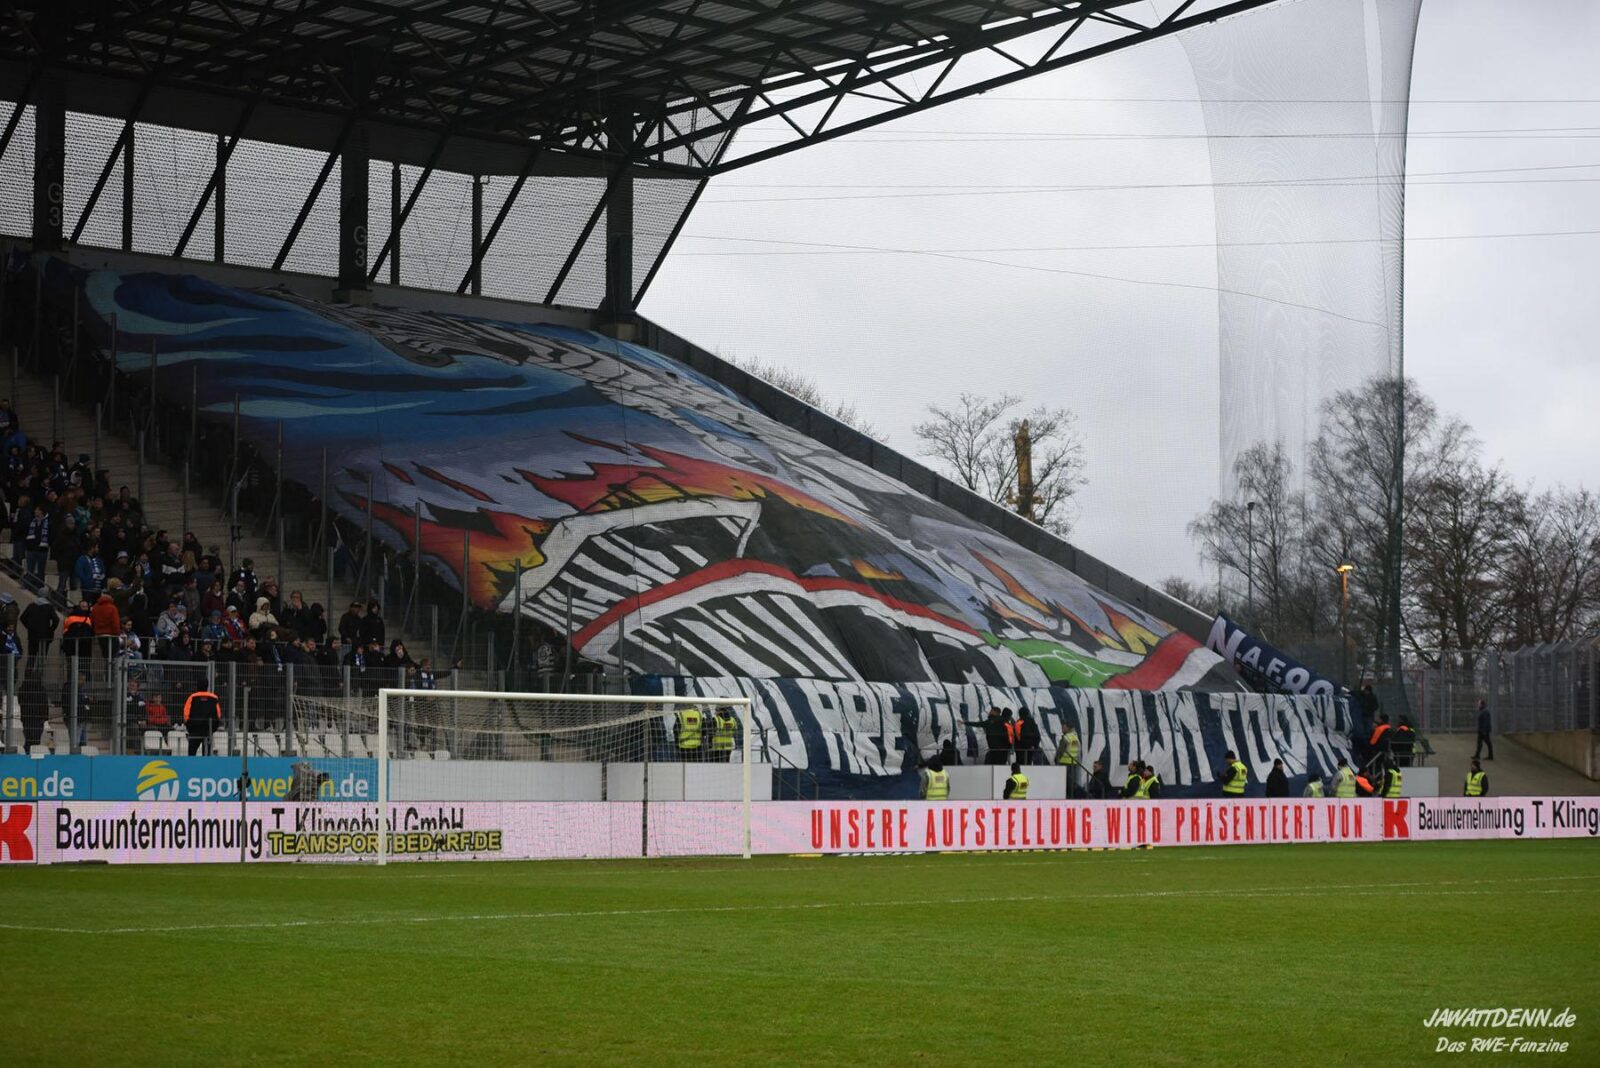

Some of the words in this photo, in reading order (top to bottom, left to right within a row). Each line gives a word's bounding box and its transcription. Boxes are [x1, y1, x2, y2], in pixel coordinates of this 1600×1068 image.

[0, 770, 75, 797] en.de
[56, 808, 263, 859] Bauunternehmung
[811, 809, 908, 849] UNSERE
[926, 807, 1092, 847] AUFSTELLUNG
[1106, 807, 1161, 844] WIRD
[1176, 803, 1315, 842] PRÄSENTIERT
[1327, 804, 1362, 838] VON
[1384, 800, 1409, 838] K
[1419, 802, 1525, 836] Bauunternehmung
[1532, 800, 1546, 828] T.
